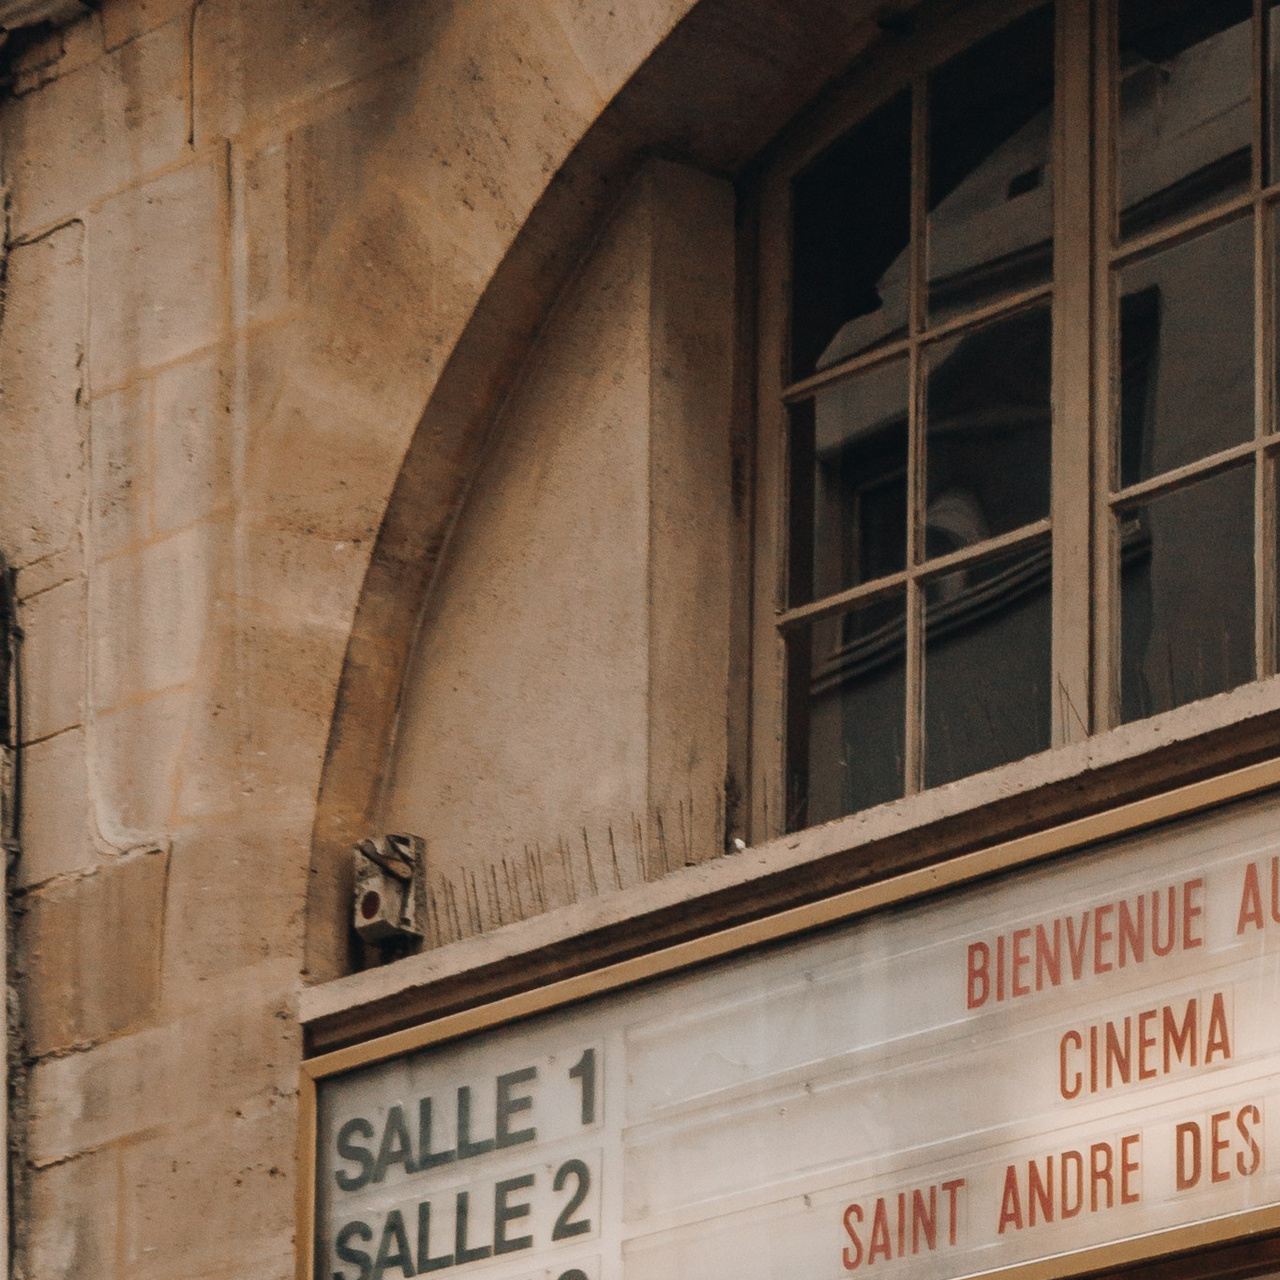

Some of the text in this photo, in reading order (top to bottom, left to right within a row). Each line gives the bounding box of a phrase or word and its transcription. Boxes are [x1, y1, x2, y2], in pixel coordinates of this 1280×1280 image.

[966, 877, 1206, 1010] BIENVENUE
[1060, 992, 1232, 1100] CINEMA
[335, 1047, 597, 1191] SALLE 1
[551, 1158, 592, 1243] 2
[842, 1178, 966, 1271] SAINT
[998, 1134, 1141, 1235] ANDRE
[1176, 1104, 1261, 1192] DES
